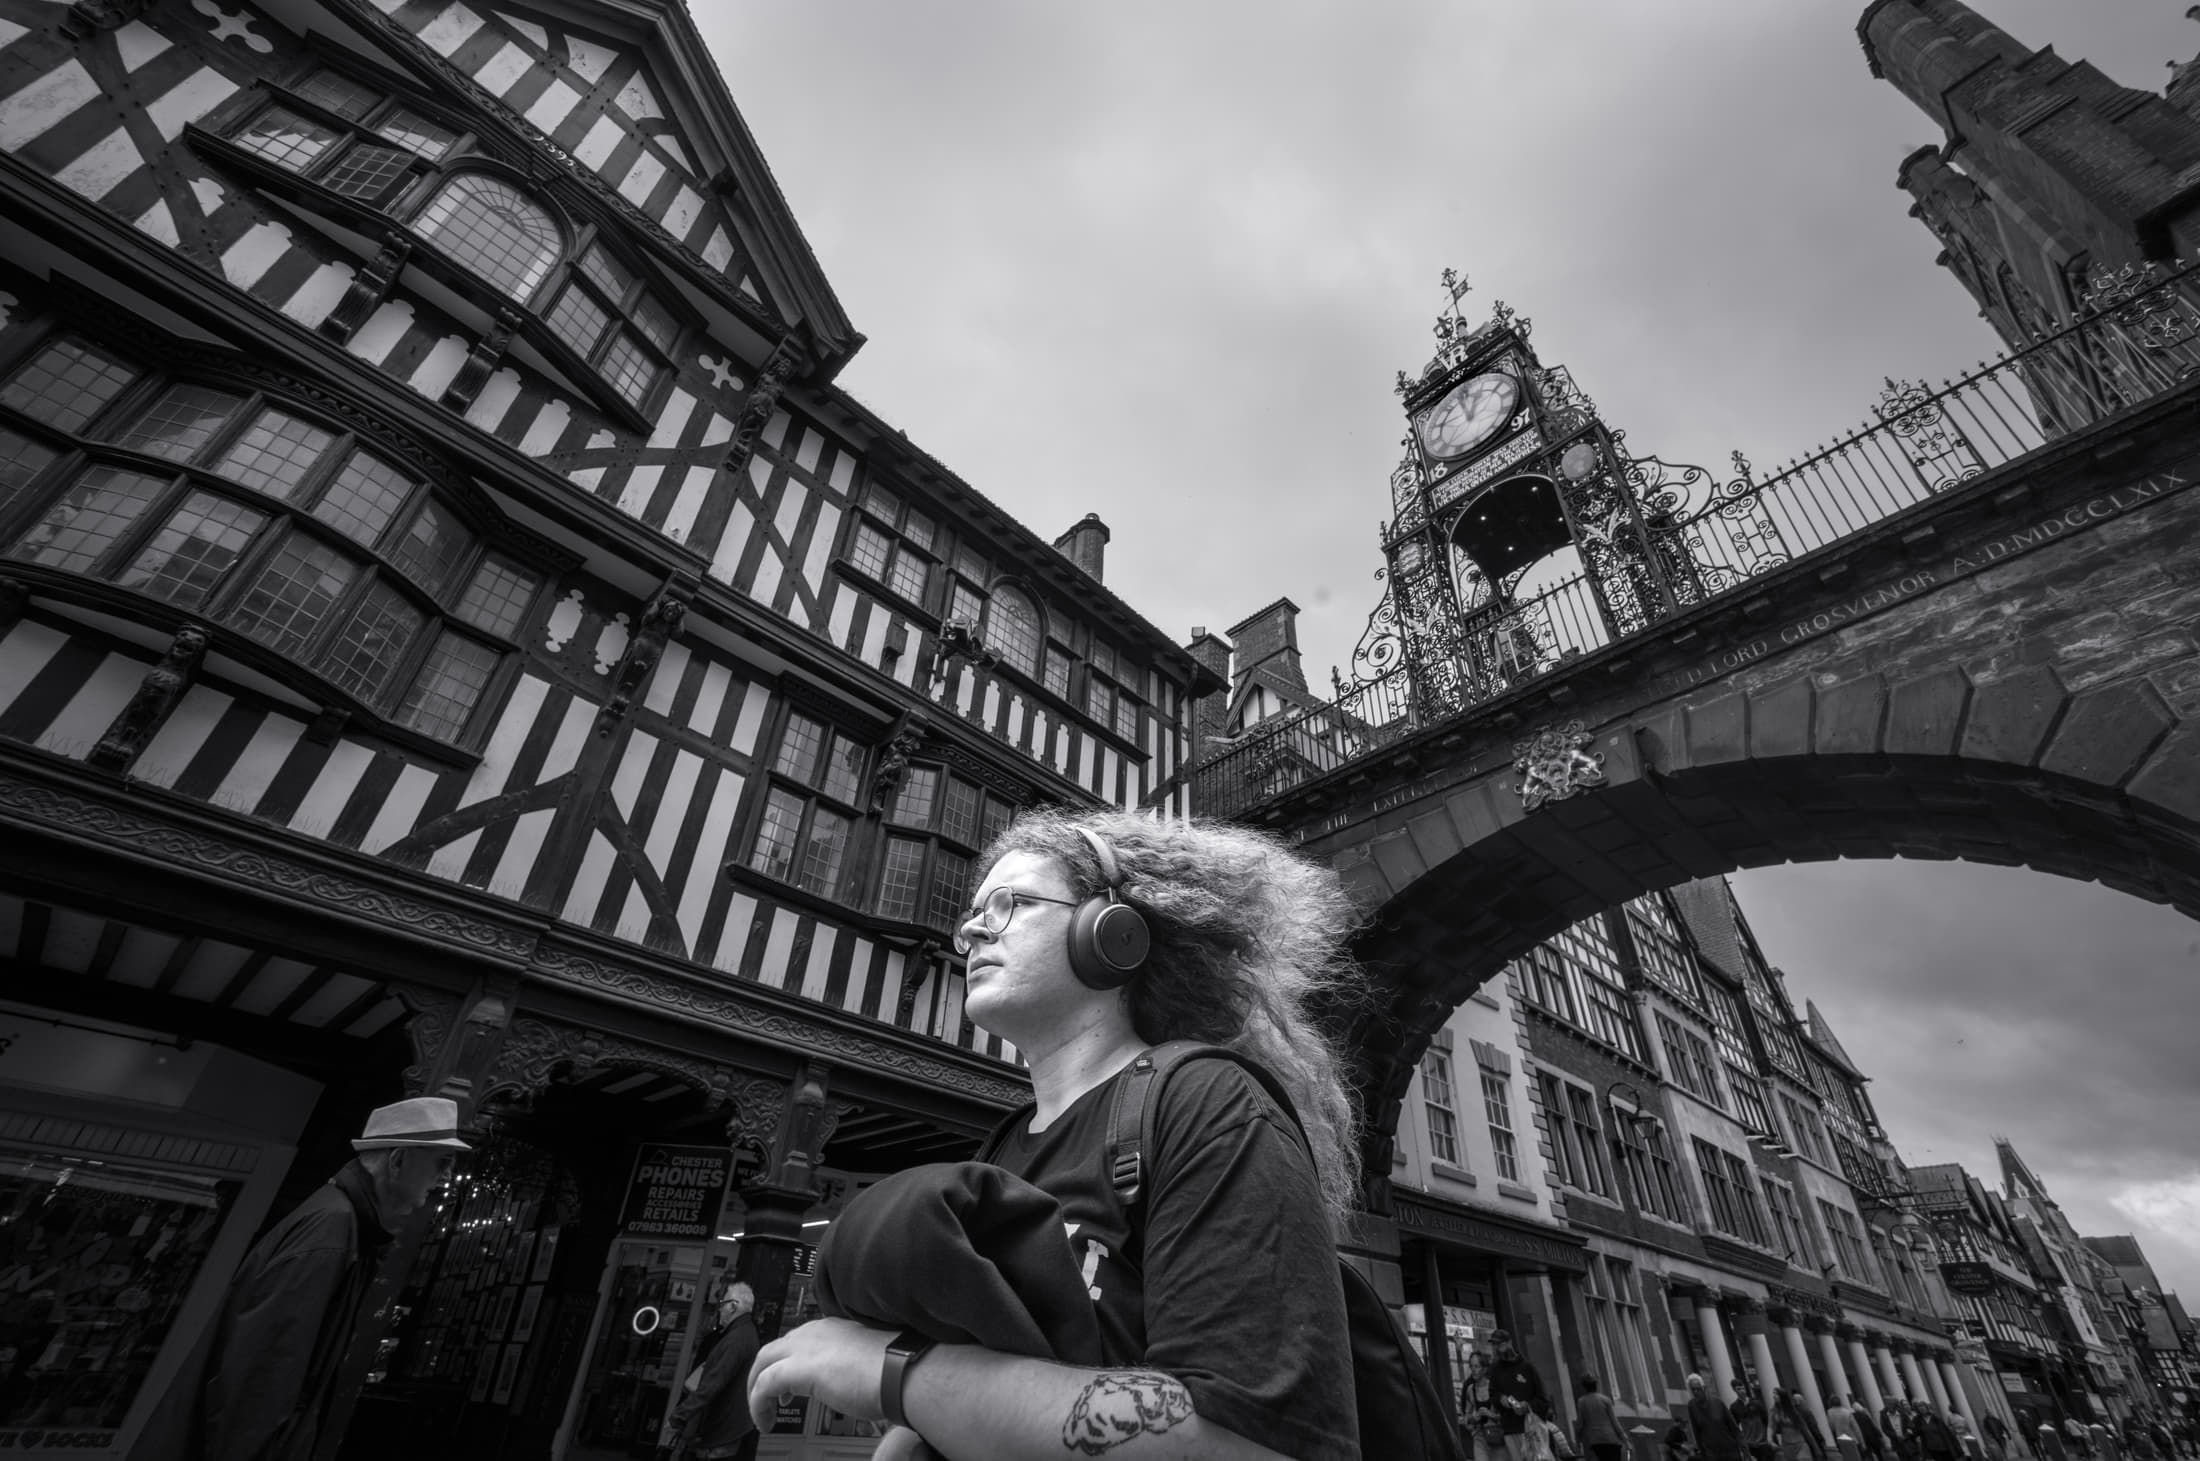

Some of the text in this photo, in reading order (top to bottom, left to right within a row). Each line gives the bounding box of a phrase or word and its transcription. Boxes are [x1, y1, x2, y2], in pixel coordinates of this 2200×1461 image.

[1510, 407, 1531, 432] 97
[1779, 569, 1937, 646] GROSVENOR
[671, 1156, 723, 1168] CHESTER
[637, 1165, 725, 1188] PHONES
[648, 1186, 706, 1201] REPAIRS
[643, 1207, 700, 1222] RETAILS
